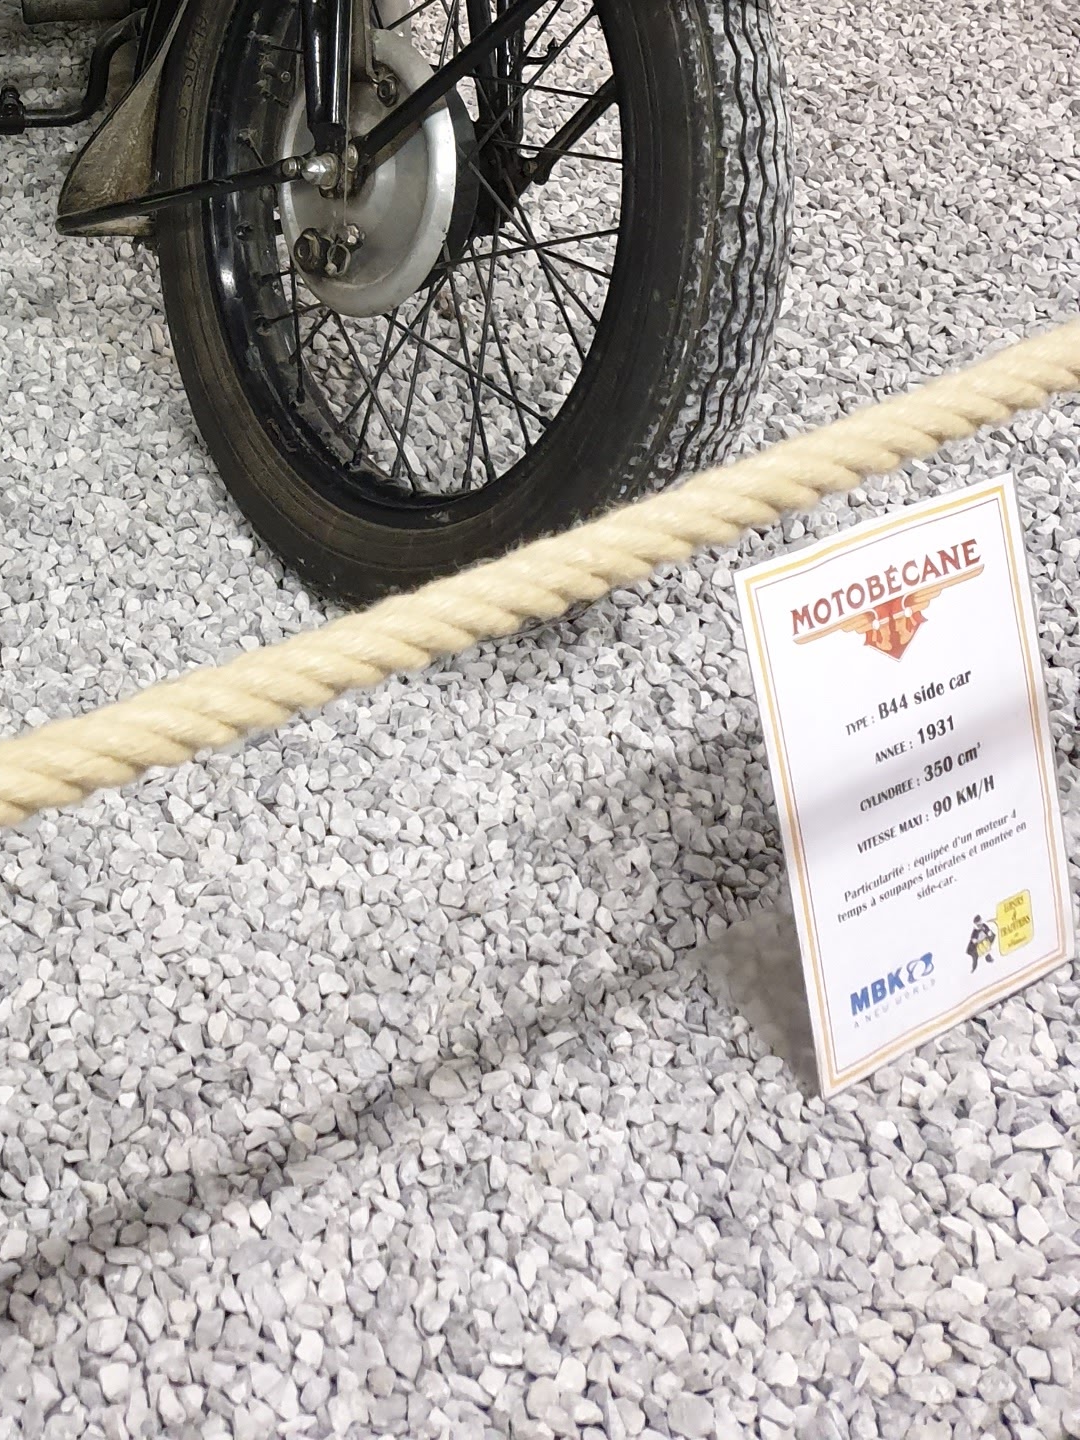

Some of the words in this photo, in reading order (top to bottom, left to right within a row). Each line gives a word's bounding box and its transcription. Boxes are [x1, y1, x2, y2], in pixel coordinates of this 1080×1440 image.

[790, 539, 981, 635] MOTOBÉCANE
[845, 716, 870, 736] TYPE
[877, 694, 909, 720] B44
[913, 681, 945, 705] side
[949, 670, 971, 691] car
[917, 715, 955, 745] 1931
[923, 755, 953, 782] 350
[857, 826, 897, 854] VITESSE
[899, 814, 923, 834] MAXI
[932, 795, 952, 818] 90
[956, 775, 995, 807] KM/H
[837, 901, 868, 924] temps
[870, 896, 877, 908] à
[879, 872, 924, 903] soupapes
[926, 852, 967, 879] latérales
[969, 846, 978, 858] et
[980, 829, 1014, 852] montée
[1016, 821, 1027, 833] en
[844, 864, 905, 902] Particularité
[913, 842, 950, 870] équipée
[952, 829, 973, 849] d'un
[975, 814, 1009, 837] moteur
[1009, 808, 1017, 819] 4
[917, 874, 958, 900] side-car.
[850, 966, 906, 1017] MBK
